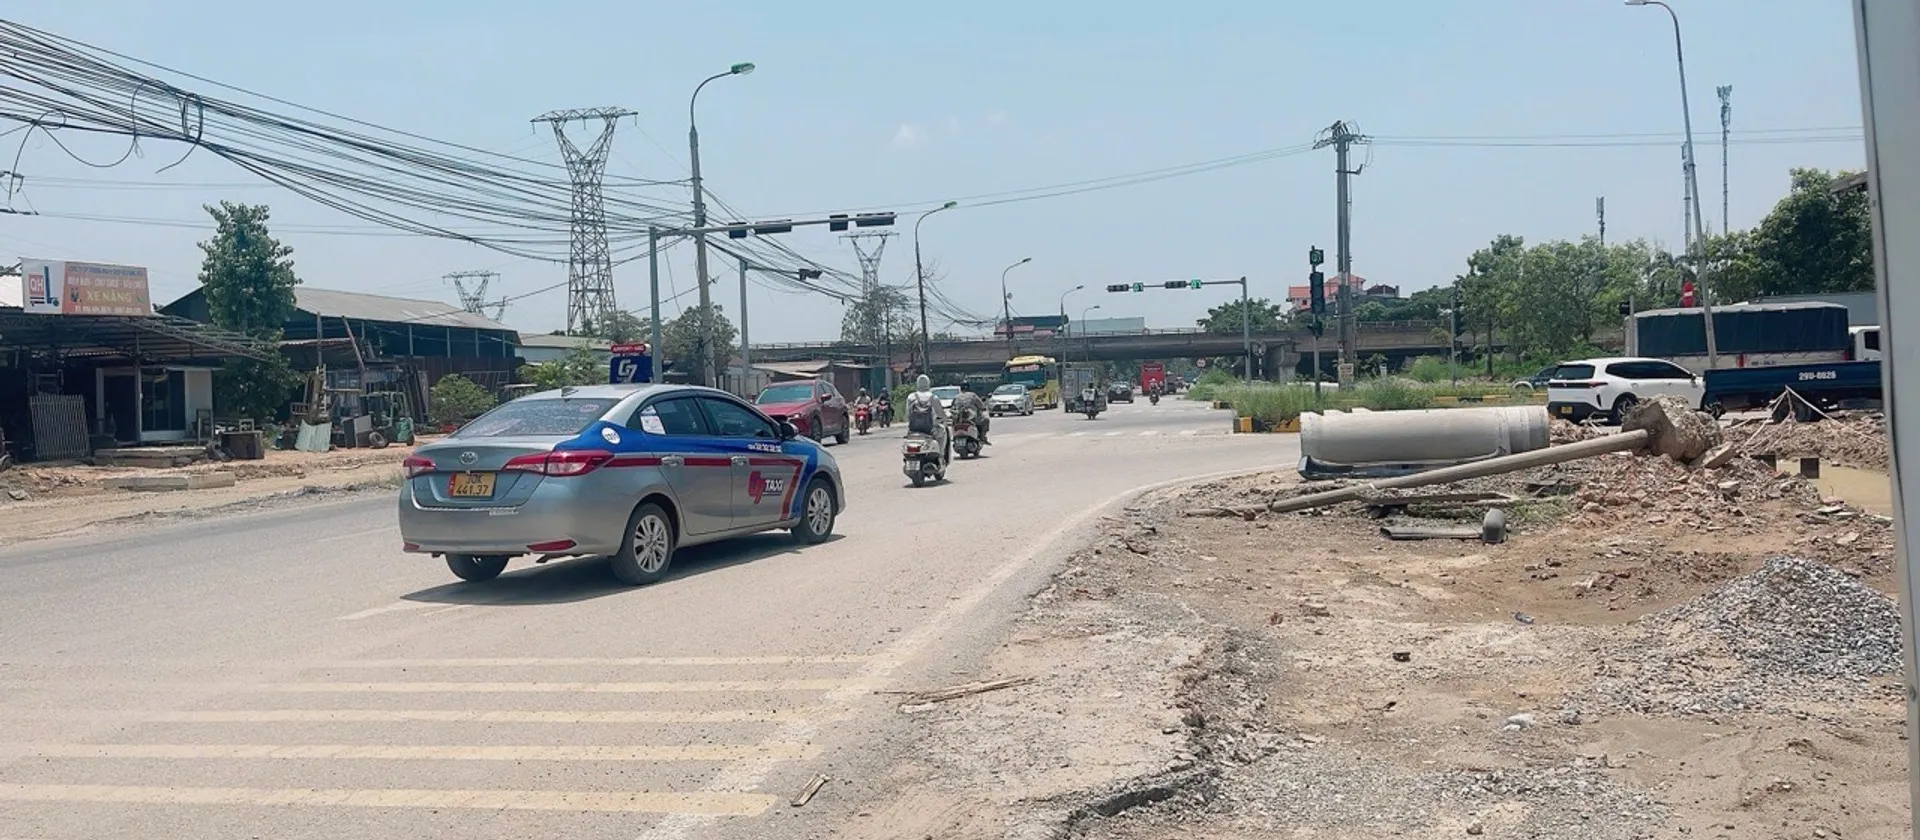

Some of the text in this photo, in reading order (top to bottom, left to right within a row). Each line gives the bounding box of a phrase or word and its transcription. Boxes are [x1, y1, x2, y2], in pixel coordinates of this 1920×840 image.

[30, 278, 43, 291] QH
[87, 290, 102, 301] XE
[618, 359, 637, 382] G7
[455, 485, 489, 496] 441.37
[764, 479, 783, 492] TAXI
